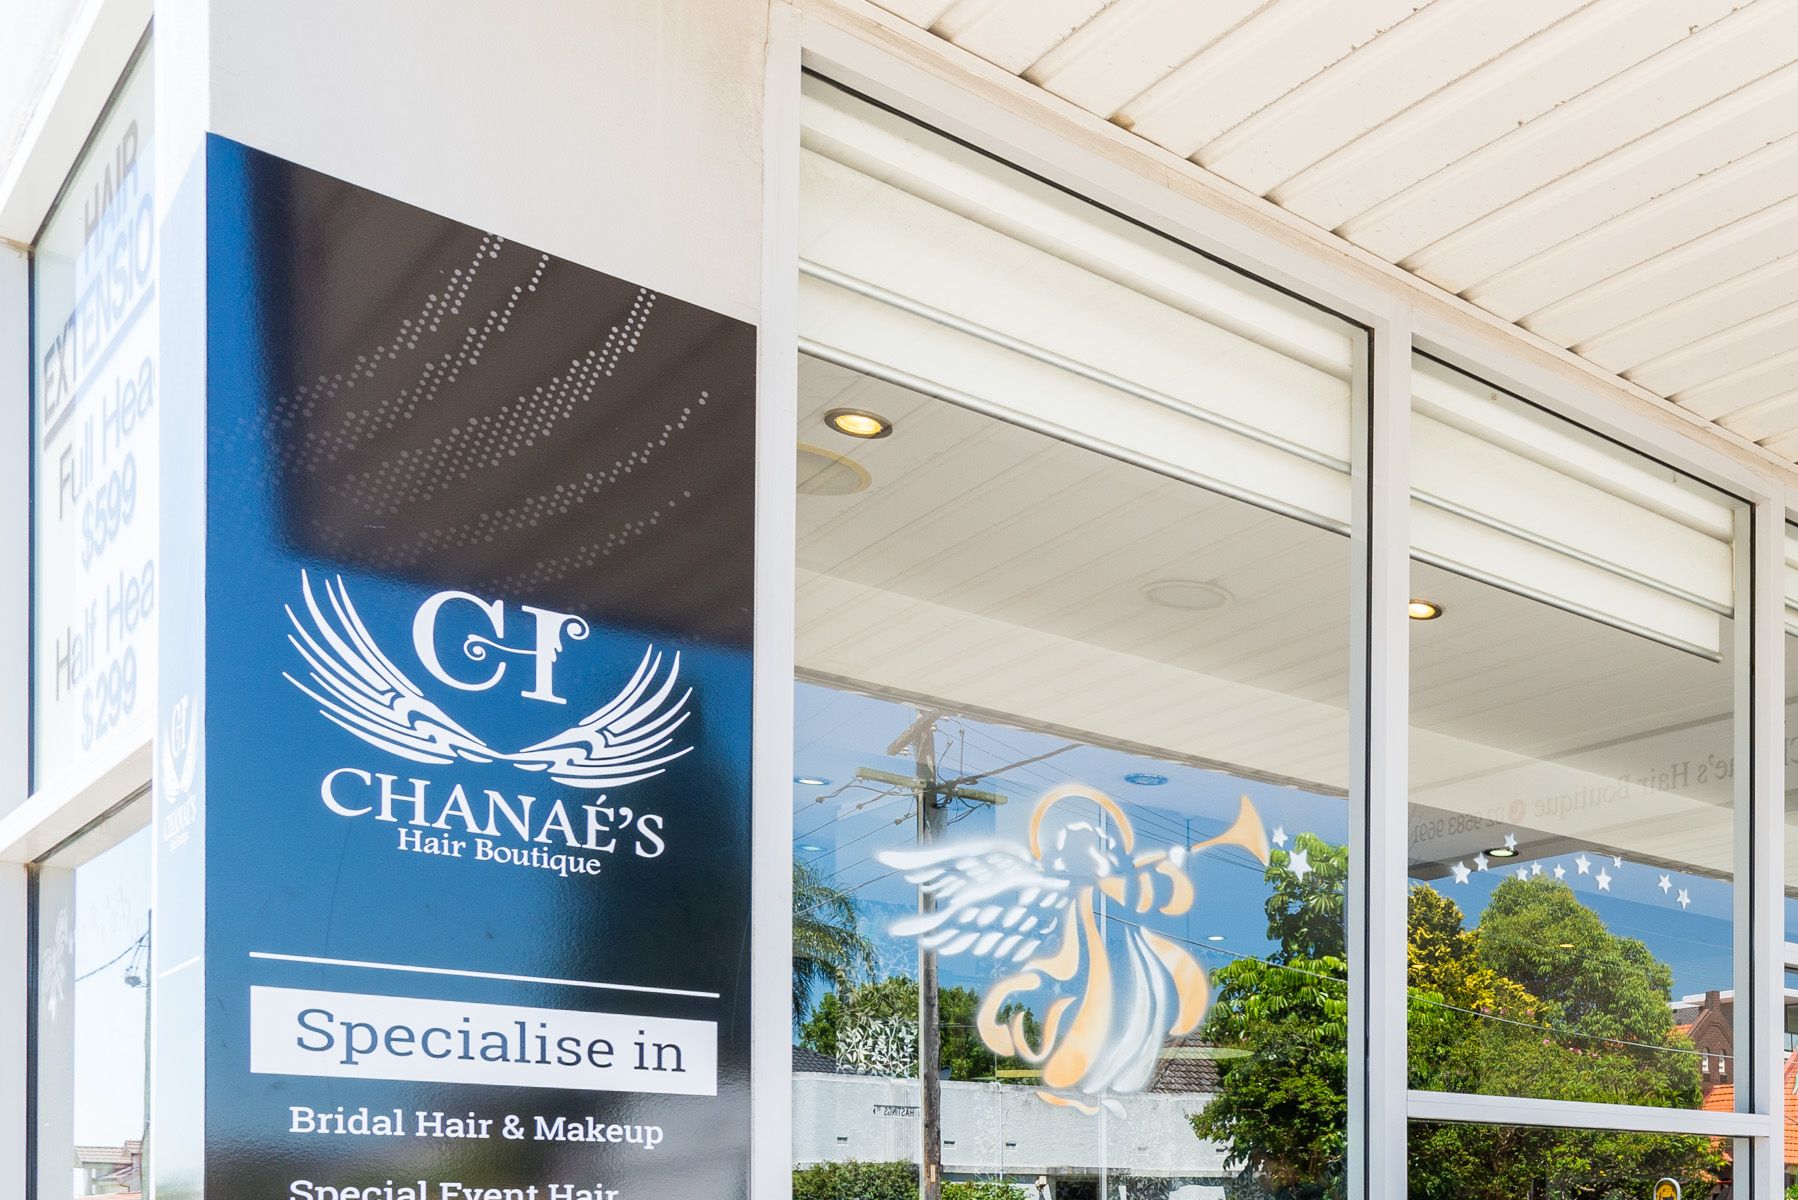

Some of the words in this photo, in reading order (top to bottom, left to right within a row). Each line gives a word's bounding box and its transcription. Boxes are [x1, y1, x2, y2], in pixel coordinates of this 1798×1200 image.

[83, 119, 138, 273] HAIR
[43, 192, 154, 426] EXTENSIO
[58, 415, 95, 522] Full
[101, 353, 154, 452] Hea
[80, 449, 137, 573] $599
[55, 600, 98, 702] Half
[105, 558, 154, 649] Hea
[80, 643, 138, 754] $299
[397, 827, 466, 858] Hair
[474, 838, 601, 878] Boutique
[296, 1008, 614, 1068] Specialise
[633, 1030, 686, 1073] in
[289, 1106, 406, 1137] Bridal
[415, 1111, 493, 1140] Hair
[502, 1114, 525, 1142] &
[533, 1115, 665, 1150] Makeup
